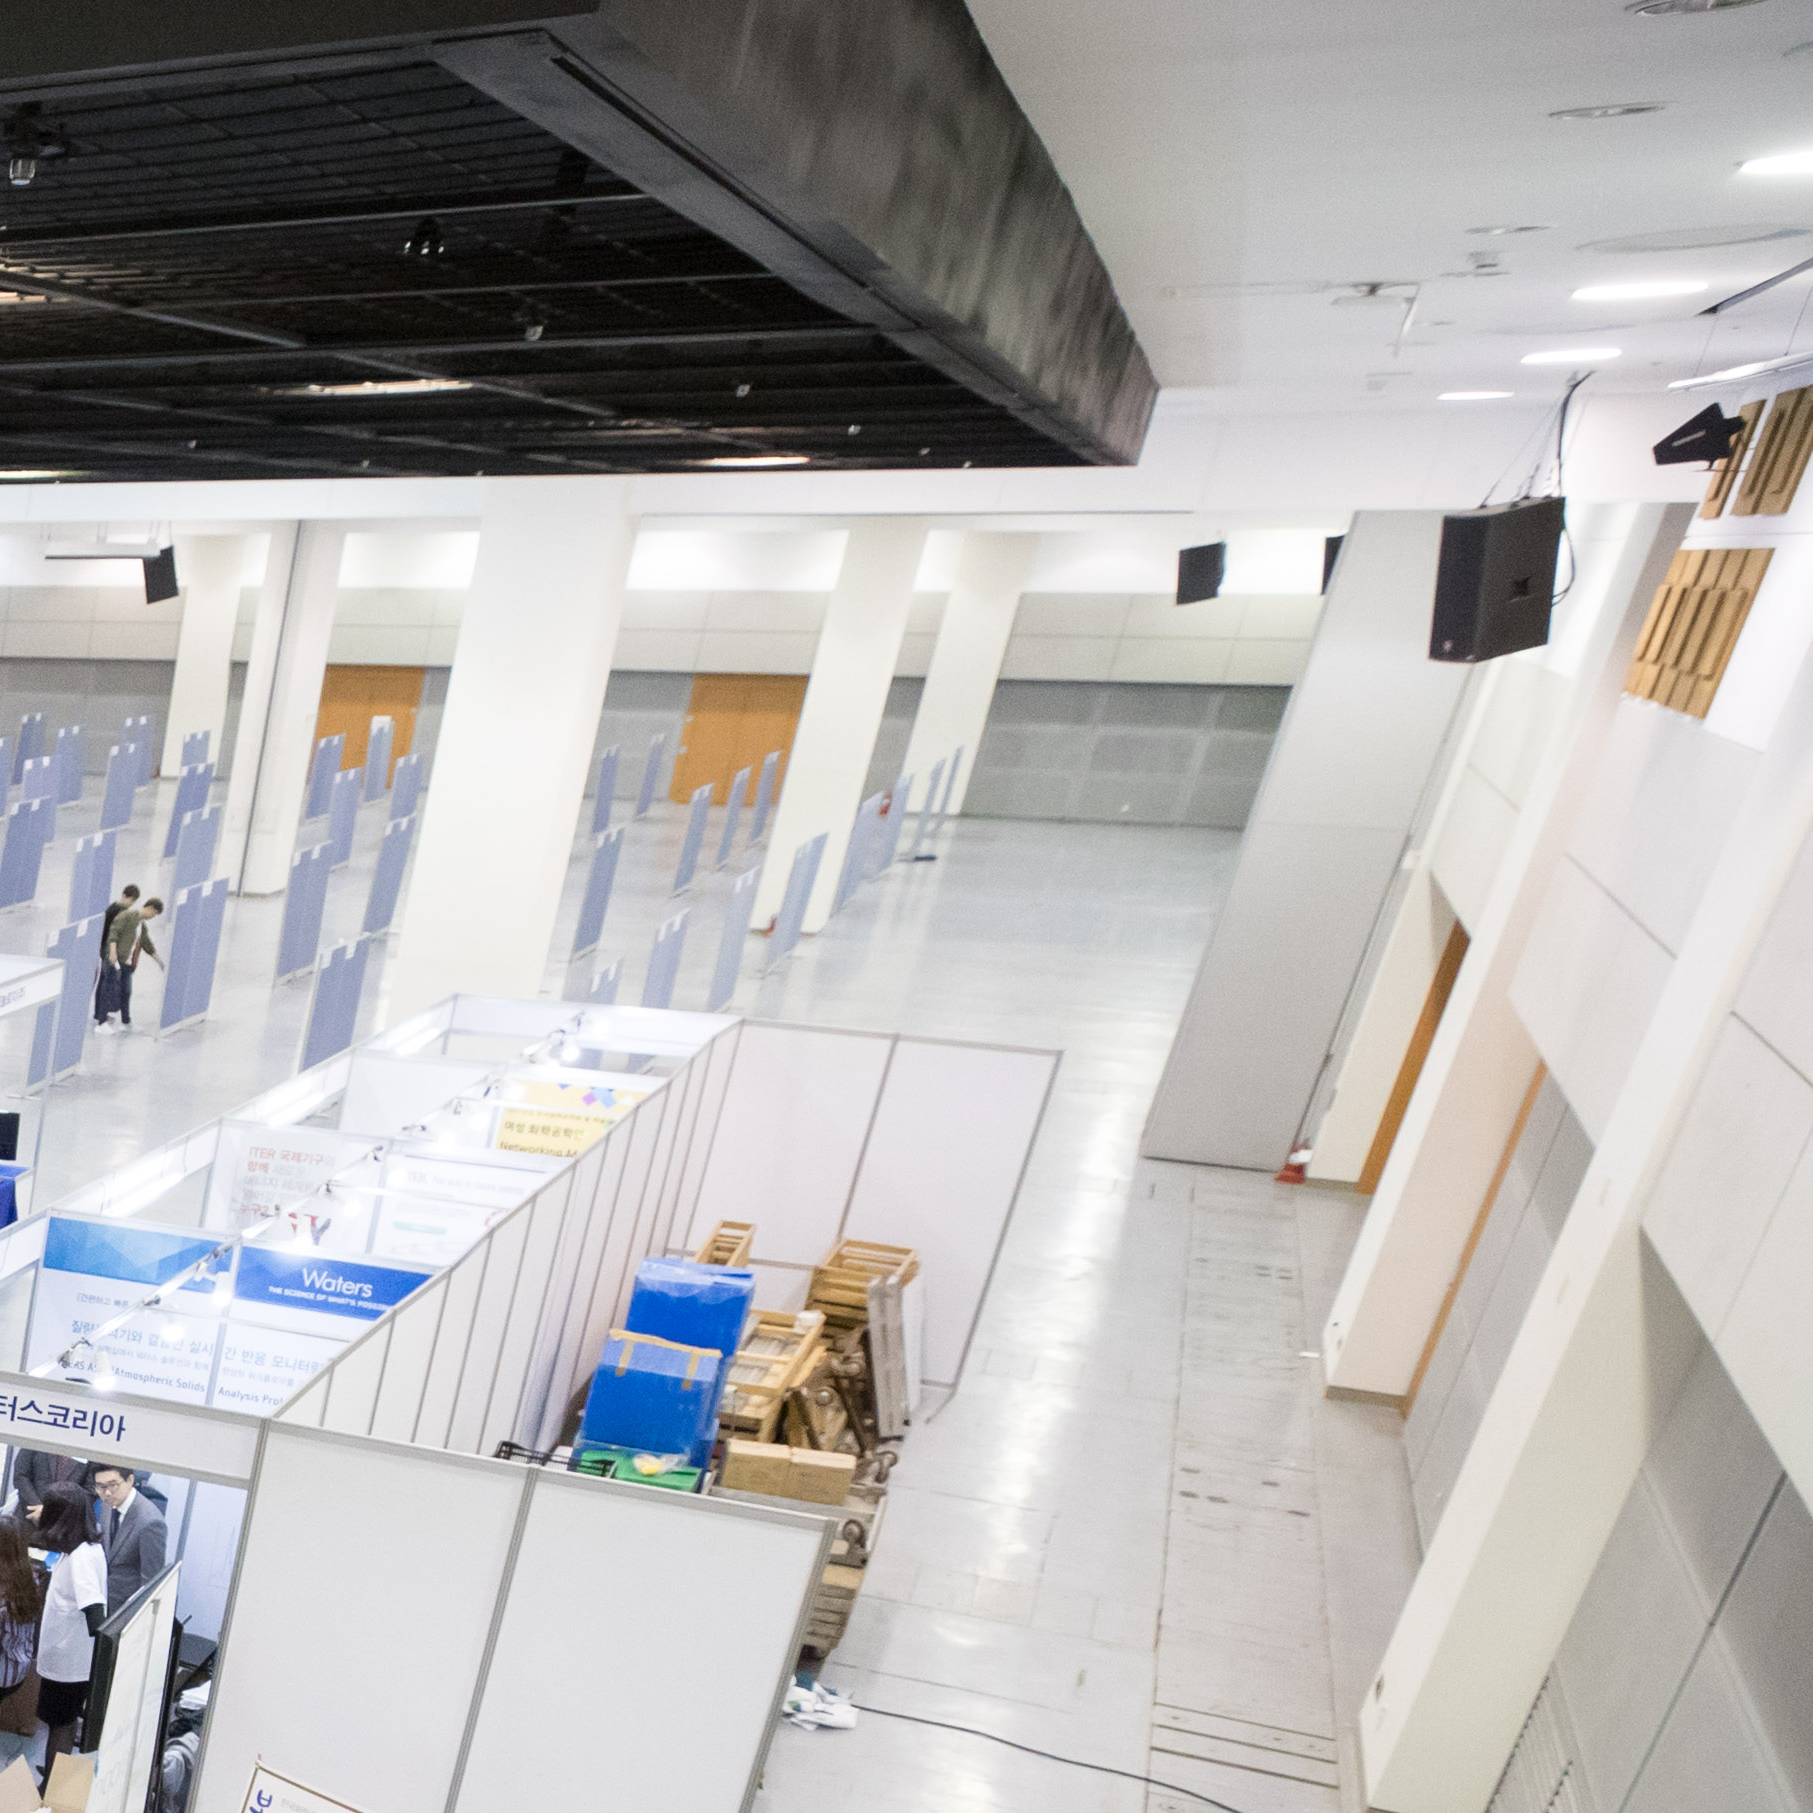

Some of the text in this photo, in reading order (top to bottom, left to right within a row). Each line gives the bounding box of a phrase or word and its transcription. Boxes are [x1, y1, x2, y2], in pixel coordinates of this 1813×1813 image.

[301, 1267, 374, 1299] Waters
[175, 1378, 206, 1393] Solids
[217, 1386, 261, 1403] Analysis
